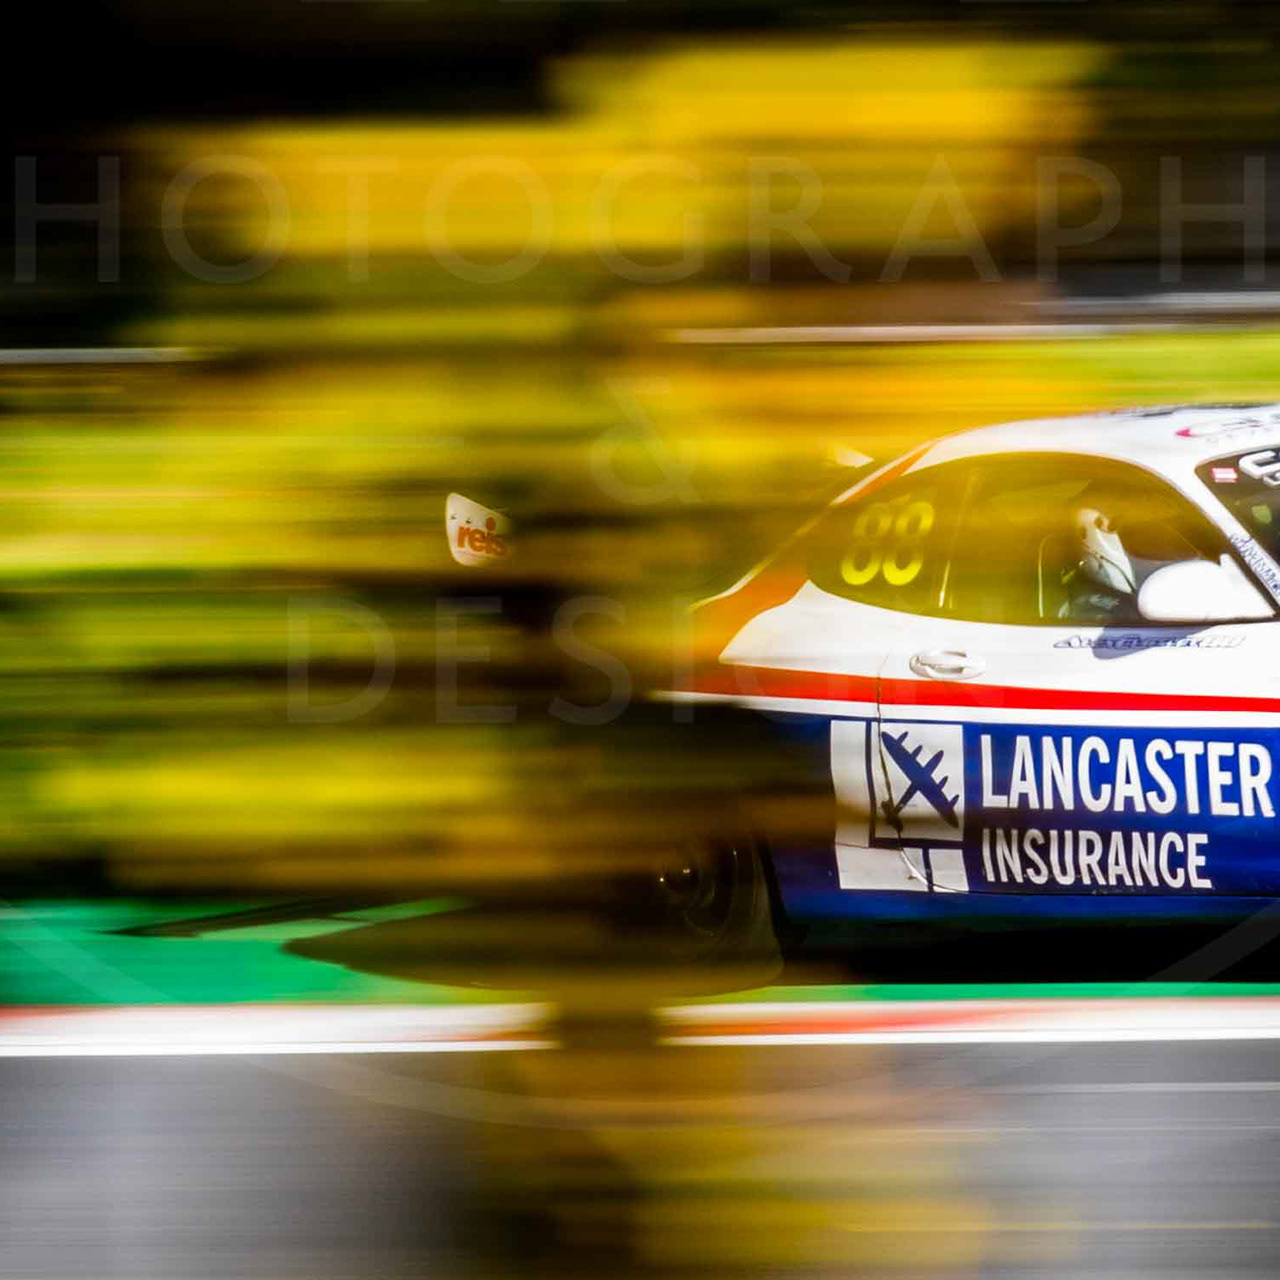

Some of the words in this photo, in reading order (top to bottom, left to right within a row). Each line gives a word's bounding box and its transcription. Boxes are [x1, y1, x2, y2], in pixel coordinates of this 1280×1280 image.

[457, 516, 507, 554] reis
[980, 733, 1276, 818] LANCASTER
[981, 828, 1214, 890] INSURANCE
